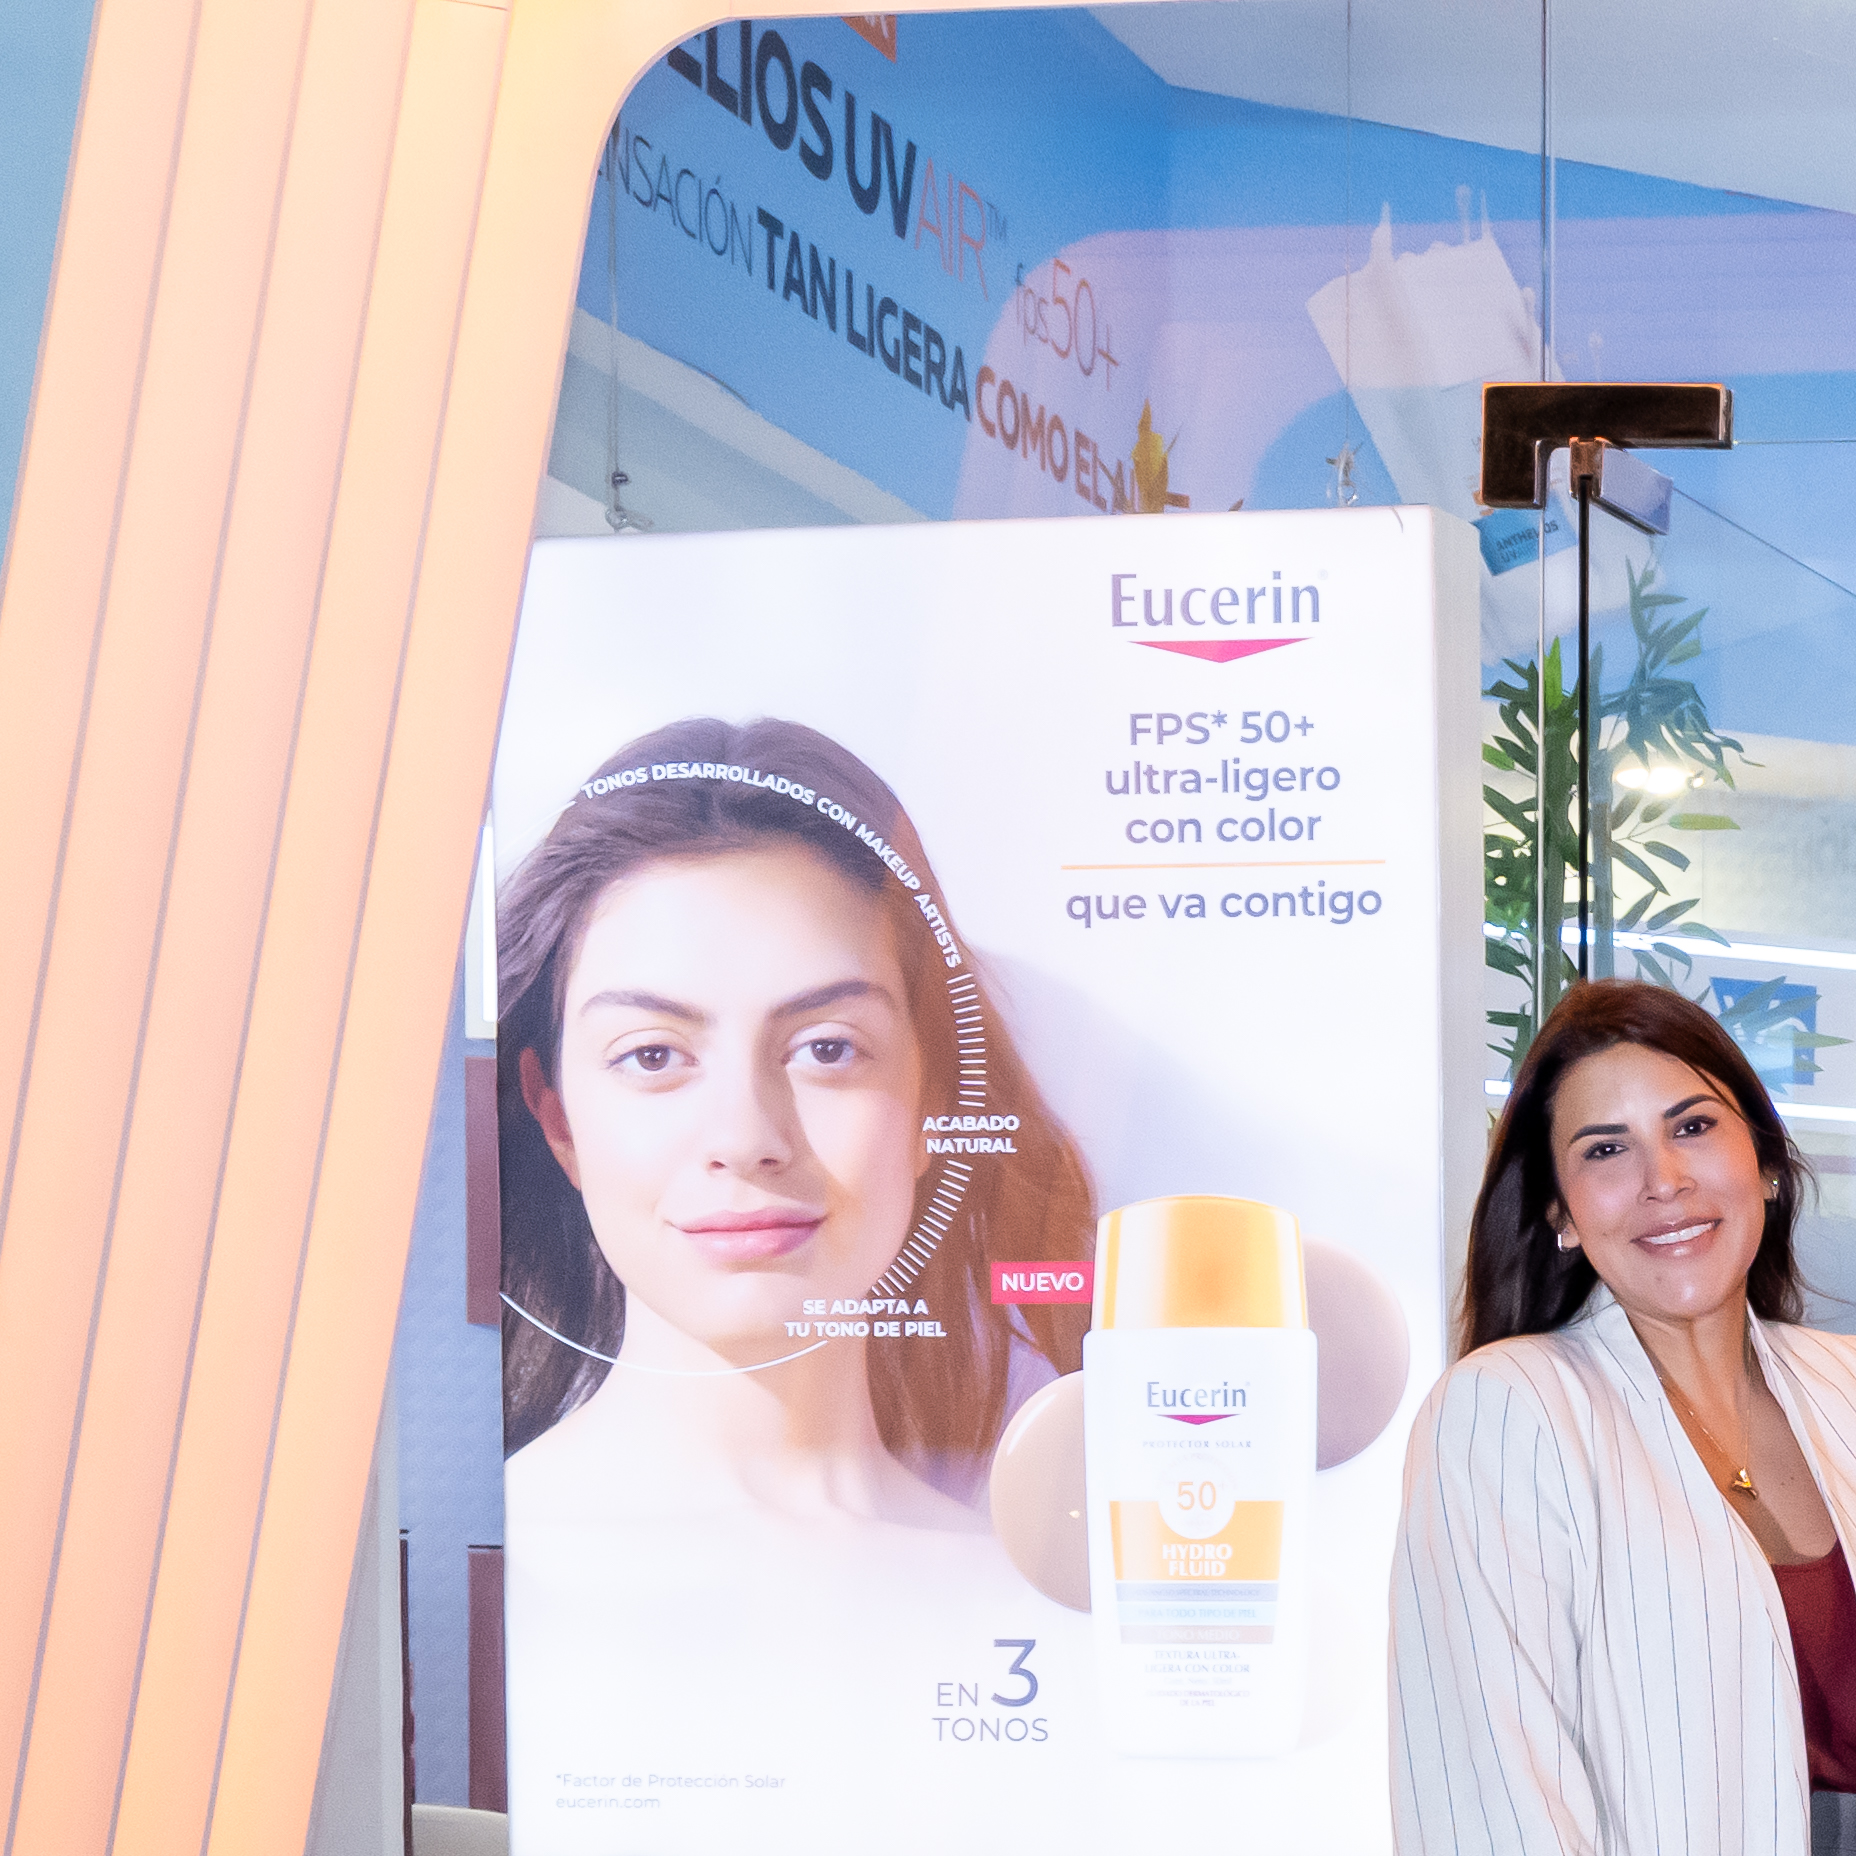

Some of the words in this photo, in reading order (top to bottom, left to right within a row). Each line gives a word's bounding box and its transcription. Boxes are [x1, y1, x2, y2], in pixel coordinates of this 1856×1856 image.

[600, 127, 752, 278] NSACIÓN
[757, 206, 836, 333] TAN
[846, 269, 971, 422] LIGERA
[975, 365, 1068, 484] COMO
[1111, 570, 1320, 628] Eucerin
[1240, 710, 1315, 744] 50+
[1105, 757, 1341, 801] ultra-ligero
[1126, 817, 1202, 843] con
[1216, 807, 1322, 843] color
[581, 767, 648, 800] TONOS
[652, 761, 816, 805] DESARROLLADOS
[817, 797, 857, 829] CON
[855, 824, 921, 890] MAKEUP
[914, 893, 962, 968] ARTISTS
[1066, 893, 1147, 928] que
[1158, 893, 1206, 919] va
[1220, 880, 1382, 925] contigo
[923, 1115, 1020, 1132] ACABADO
[926, 1138, 1018, 1154] NATURAL
[1002, 1272, 1084, 1292] NUEVO
[803, 1299, 827, 1315] SE
[831, 1299, 910, 1315] ADAPTA
[913, 1299, 928, 1315] A
[785, 1322, 810, 1337] TU
[813, 1322, 869, 1337] TONO
[874, 1322, 901, 1337] DE
[905, 1322, 947, 1337] PIEL
[1147, 1381, 1247, 1408] Eucerin
[1162, 1543, 1232, 1560] HYDRO
[1168, 1561, 1226, 1577] FLUID
[937, 1683, 978, 1707] EN
[991, 1639, 1039, 1707] 3
[932, 1717, 1049, 1742] TONOS
[621, 1773, 643, 1788] de
[647, 1772, 740, 1788] Protección
[744, 1774, 787, 1788] Solar
[555, 1795, 661, 1810] eucerin.com
